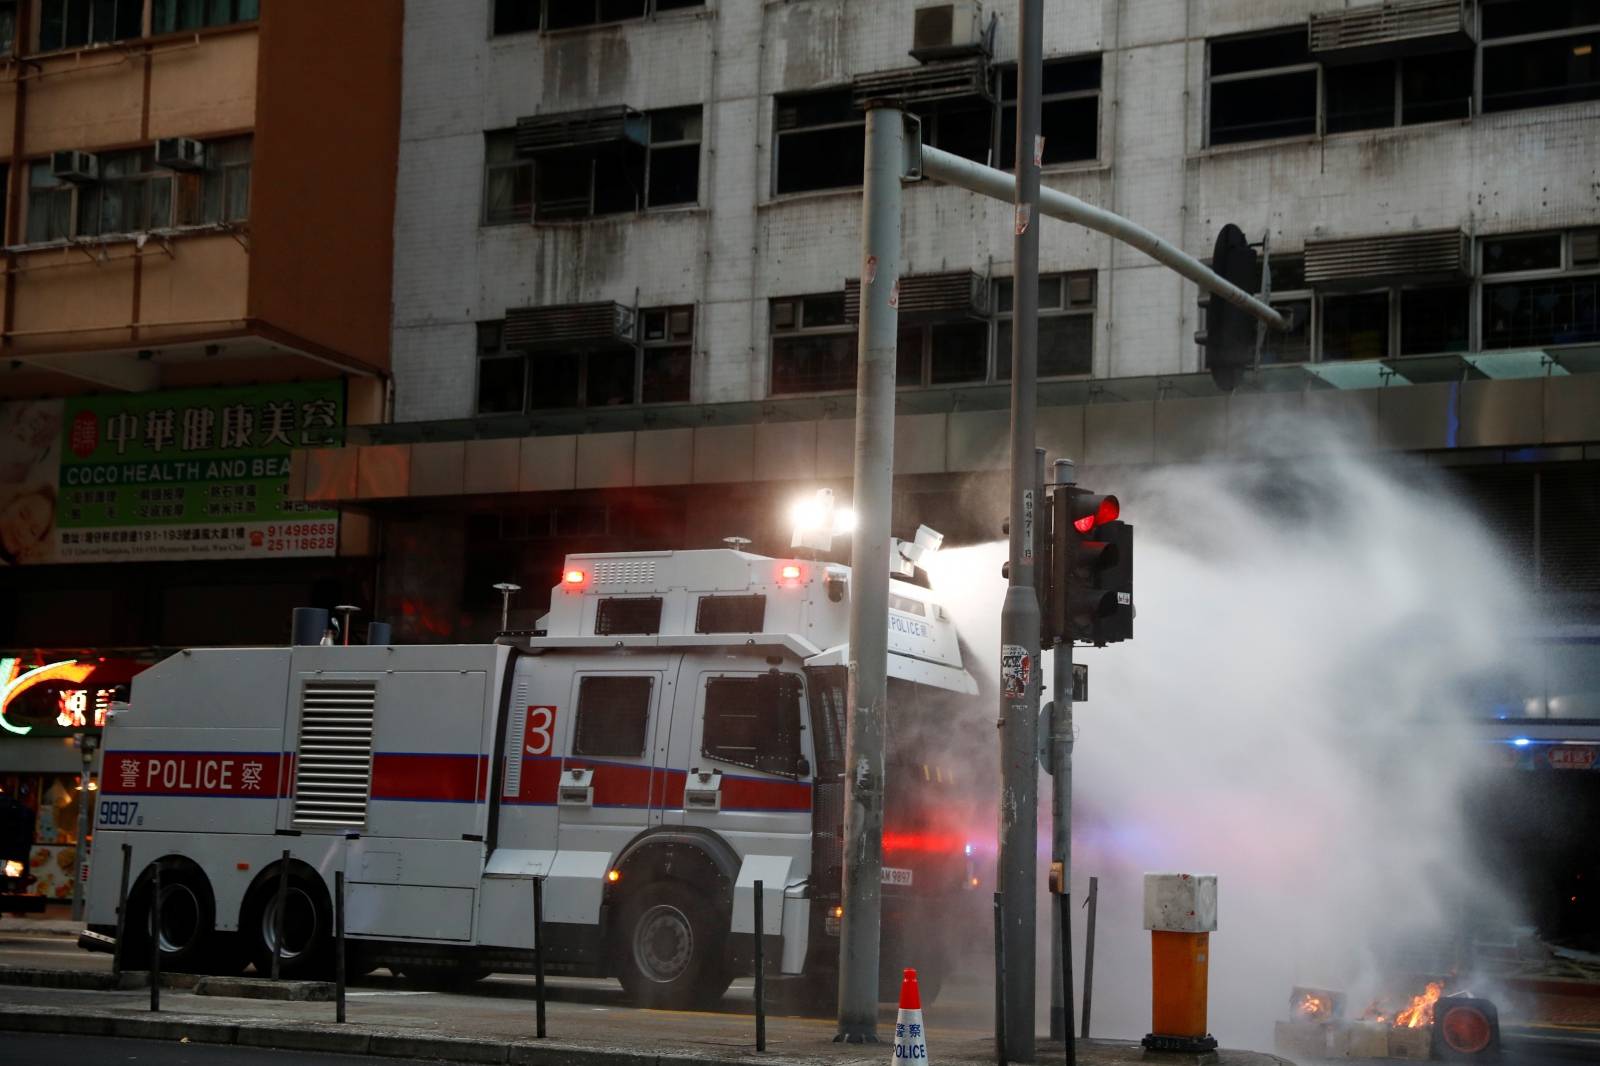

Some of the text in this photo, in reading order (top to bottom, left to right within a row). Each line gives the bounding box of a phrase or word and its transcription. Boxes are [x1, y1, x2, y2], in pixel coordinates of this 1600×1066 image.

[106, 399, 337, 455] 中華健康美容
[67, 464, 118, 484] COCO
[122, 461, 200, 481] HEALTH
[206, 460, 246, 479] AND
[891, 616, 920, 636] POLICE
[526, 707, 552, 755] 3
[120, 758, 263, 790] 警 POLICE 察
[99, 801, 138, 826] 9897
